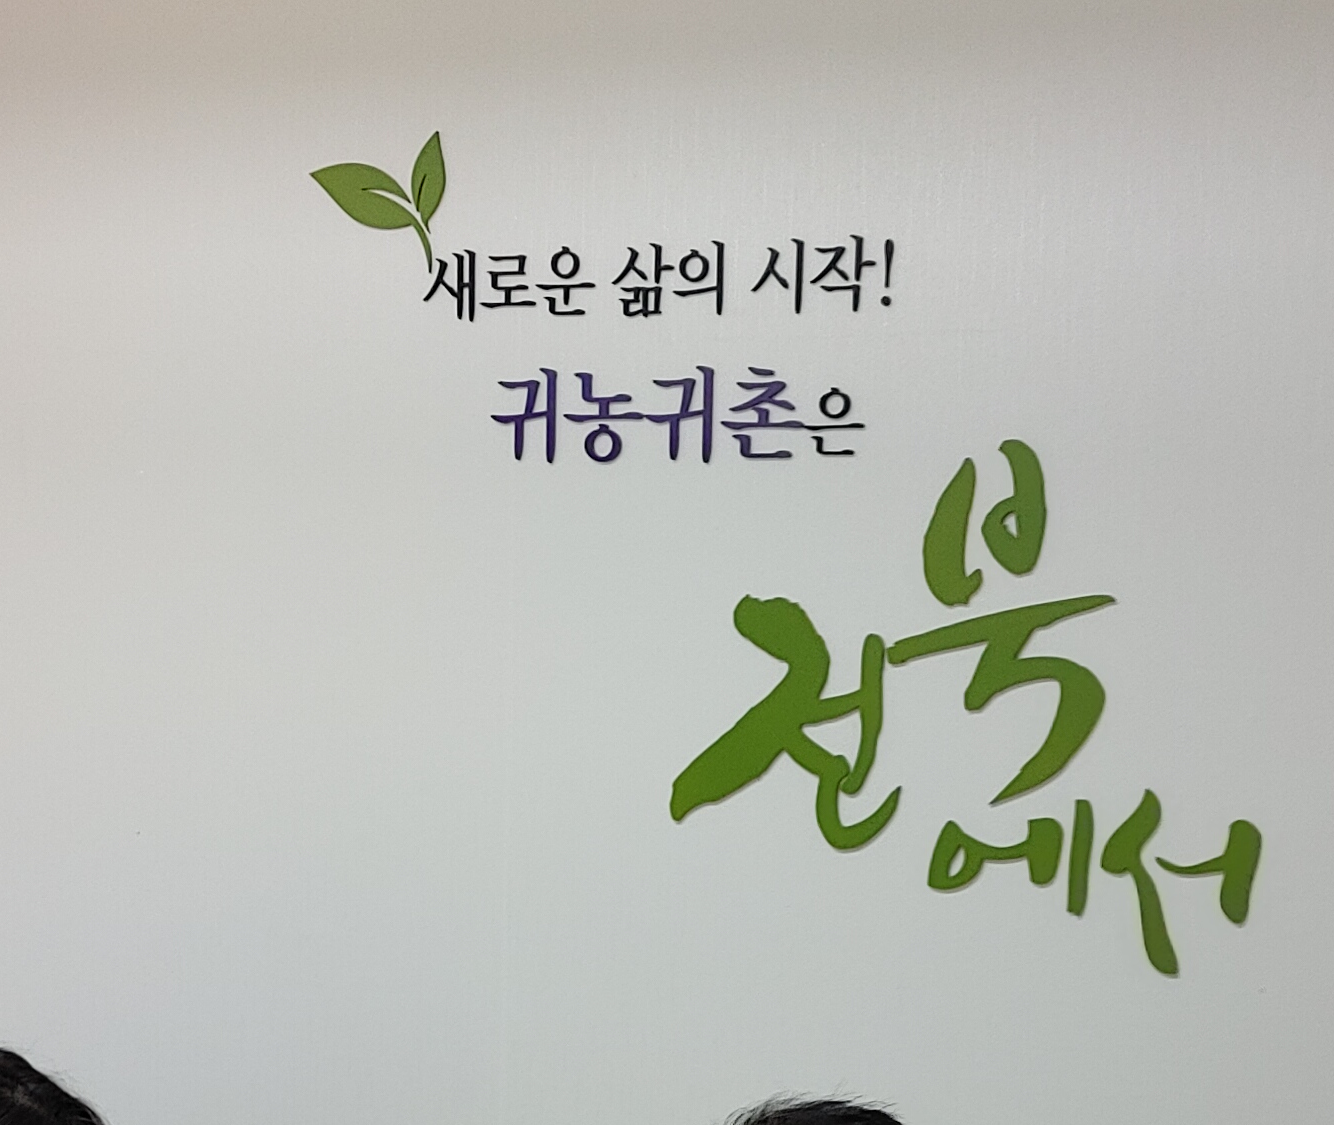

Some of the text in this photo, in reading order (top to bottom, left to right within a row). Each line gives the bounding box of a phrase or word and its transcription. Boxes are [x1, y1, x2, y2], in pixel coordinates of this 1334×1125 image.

[422, 234, 896, 322] 새로운 삶의 시작!
[490, 365, 866, 464] 귀농귀촌은
